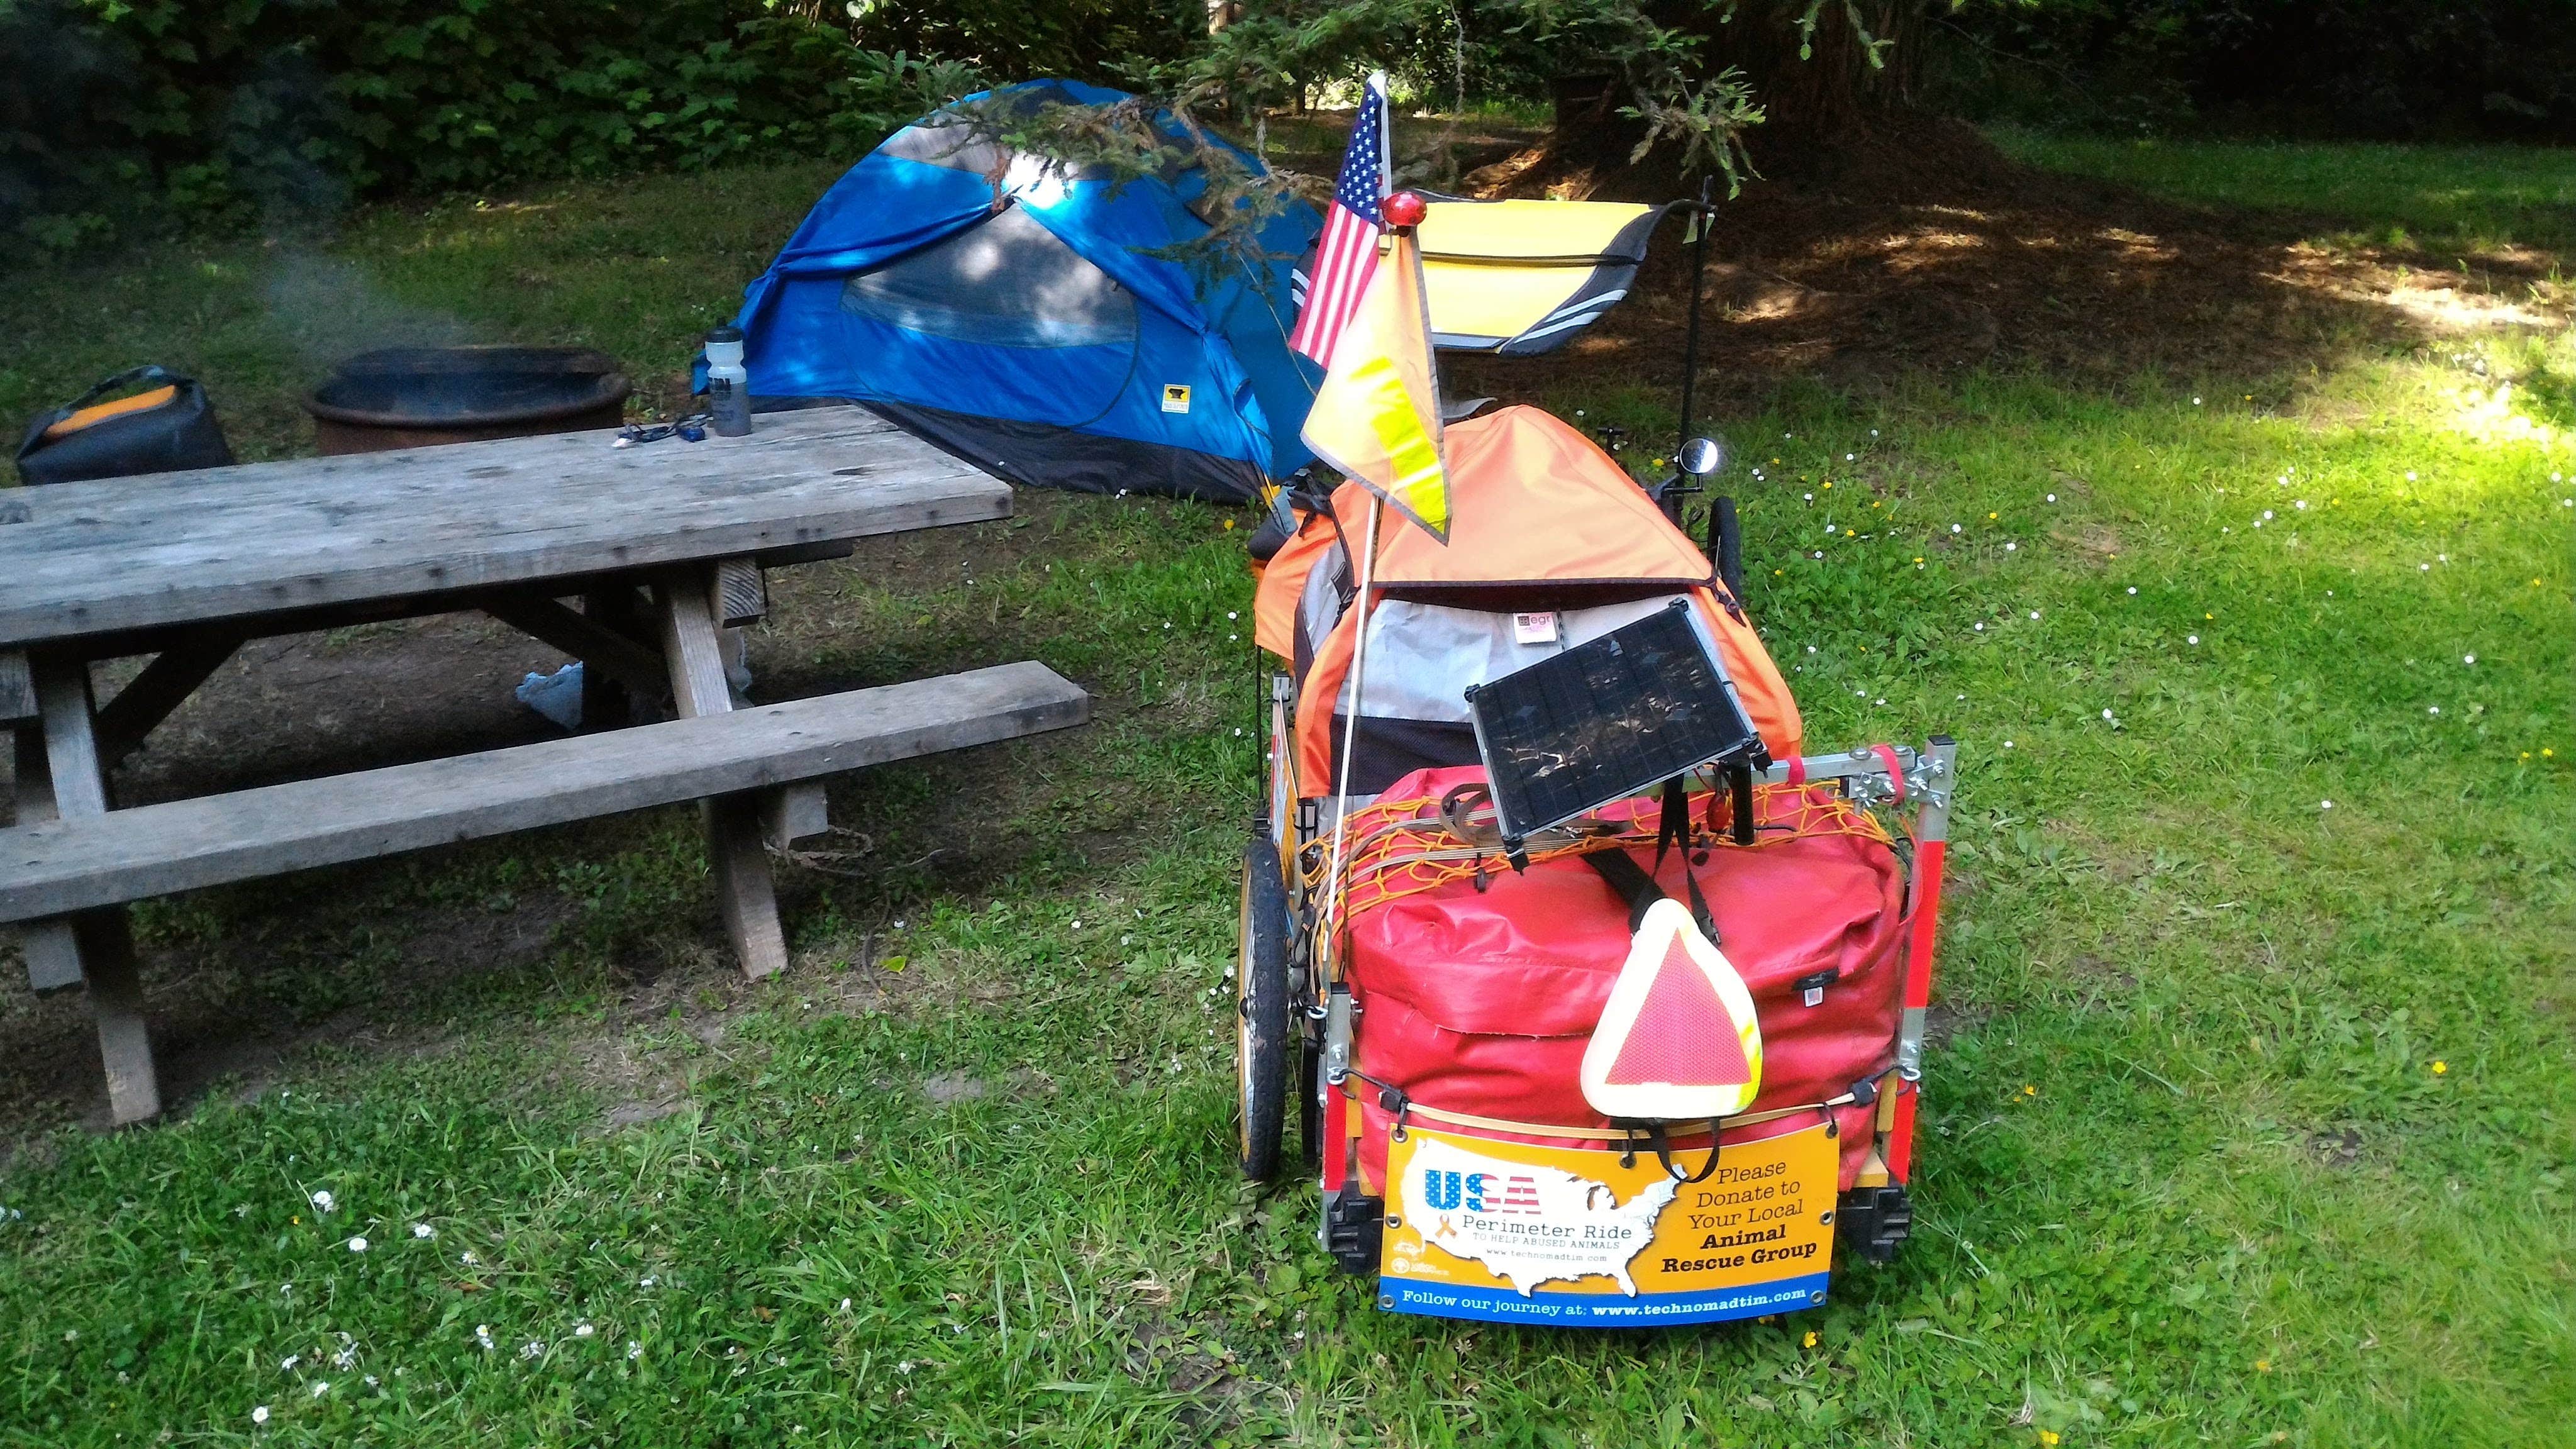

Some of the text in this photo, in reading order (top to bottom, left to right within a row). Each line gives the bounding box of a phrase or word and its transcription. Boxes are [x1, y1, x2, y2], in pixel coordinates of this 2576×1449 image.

[1717, 1162, 1786, 1184] Please
[1425, 1169, 1541, 1214] USA
[1696, 1180, 1801, 1208] Donate to
[1462, 1214, 1632, 1239] Perimeter Ride
[1688, 1199, 1803, 1230] Your Local
[1474, 1232, 1620, 1250] TO HELP ABUSED ANIMALS
[1700, 1224, 1786, 1249] Animal
[1486, 1248, 1607, 1262] wwwtechnomadtimcom
[1661, 1242, 1817, 1273] Rescue Group
[1402, 1287, 1806, 1317] Follow our journey at: www.technomadtim.com
